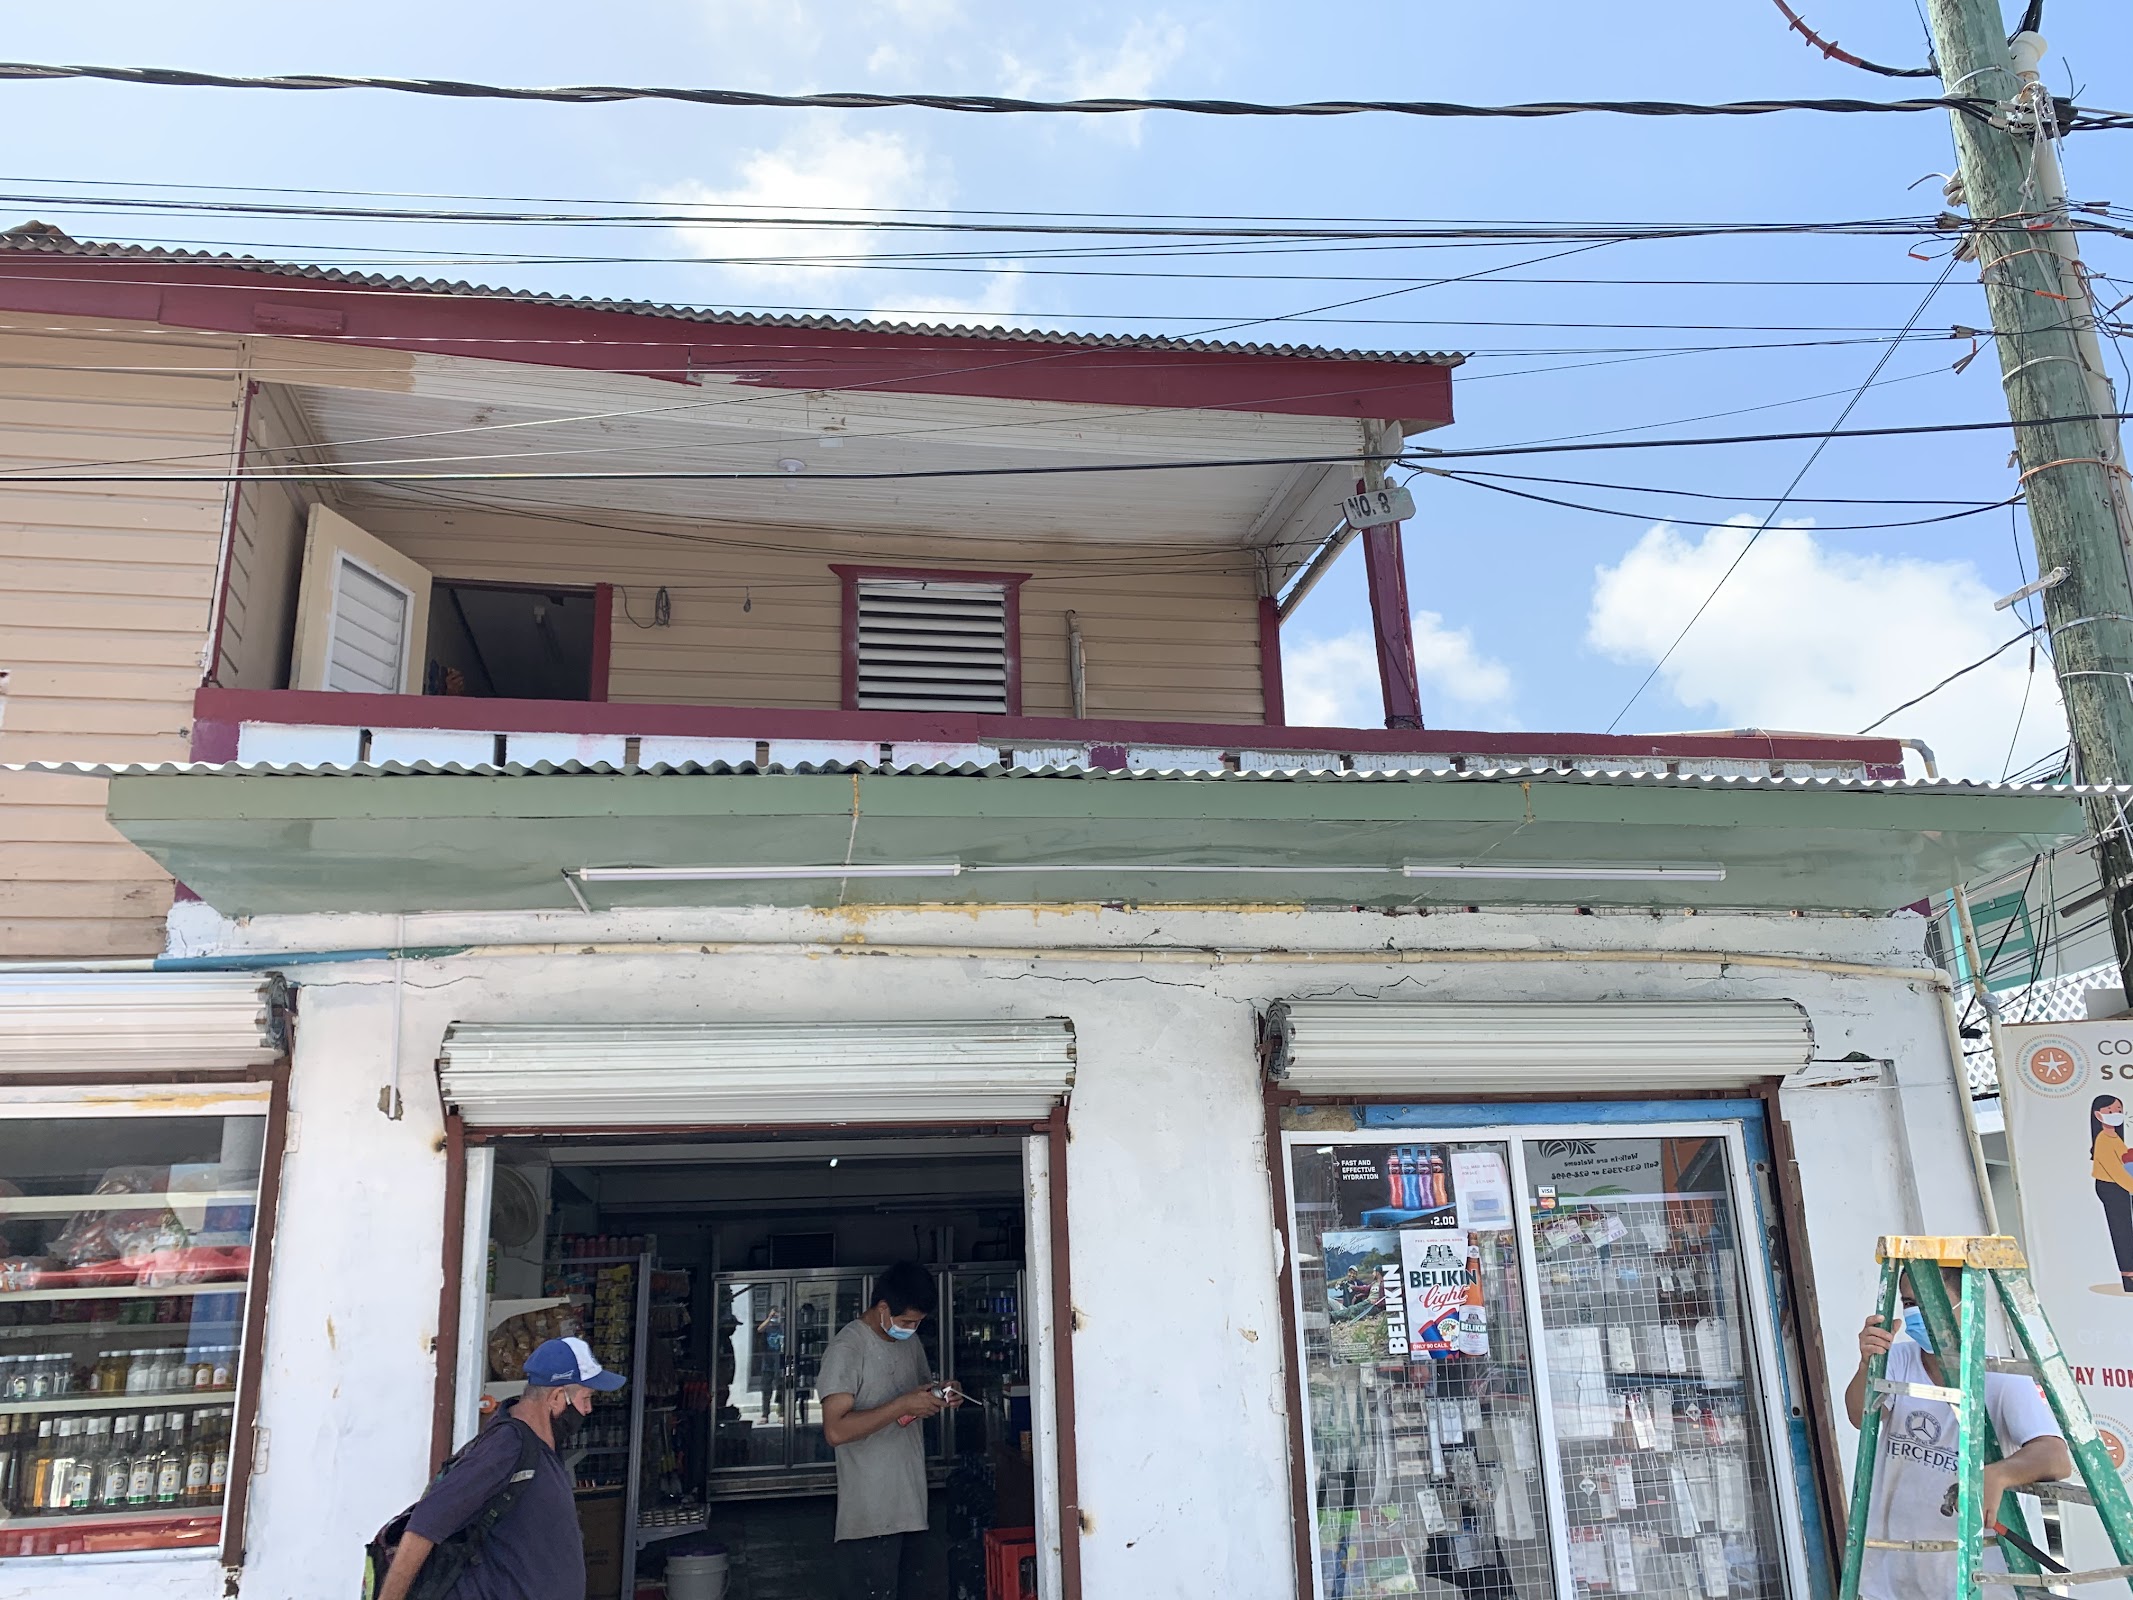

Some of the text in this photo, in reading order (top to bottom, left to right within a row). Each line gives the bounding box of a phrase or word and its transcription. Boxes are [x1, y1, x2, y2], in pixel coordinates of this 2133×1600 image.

[1348, 495, 1376, 519] NO.
[2098, 1040, 2133, 1055] CO
[1410, 1270, 1477, 1288] BELIKIN
[1419, 1284, 1470, 1310] light
[1382, 1264, 1408, 1354] BELIKIN
[1460, 1322, 1487, 1332] BELIKIN
[2070, 1366, 2094, 1385] AY
